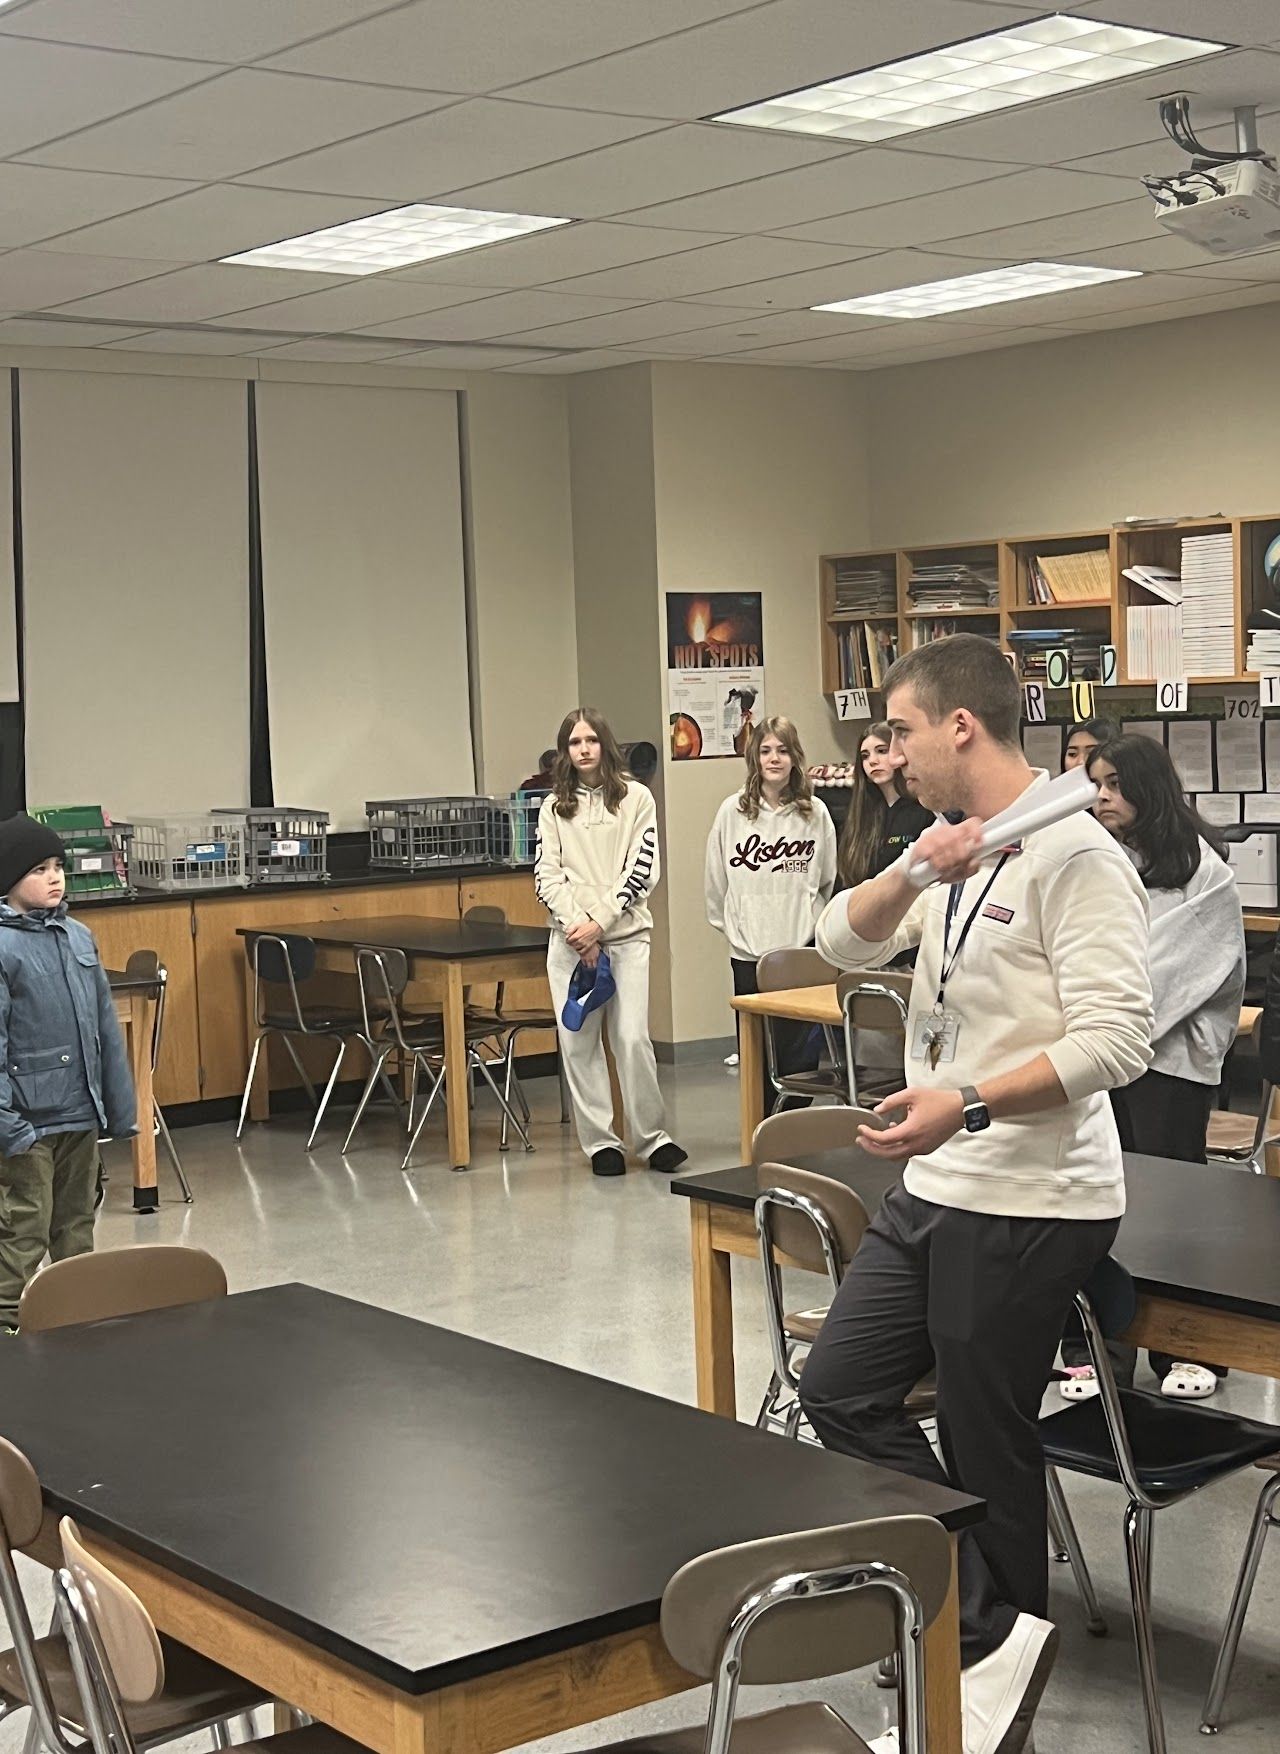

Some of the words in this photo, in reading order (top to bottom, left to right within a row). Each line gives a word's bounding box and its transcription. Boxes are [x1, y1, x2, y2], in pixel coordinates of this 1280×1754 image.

[674, 643, 703, 668] HOT
[709, 643, 759, 668] SPOTS
[1161, 683, 1183, 708] OF
[1226, 699, 1260, 719] 702
[729, 833, 816, 872] Lisbon
